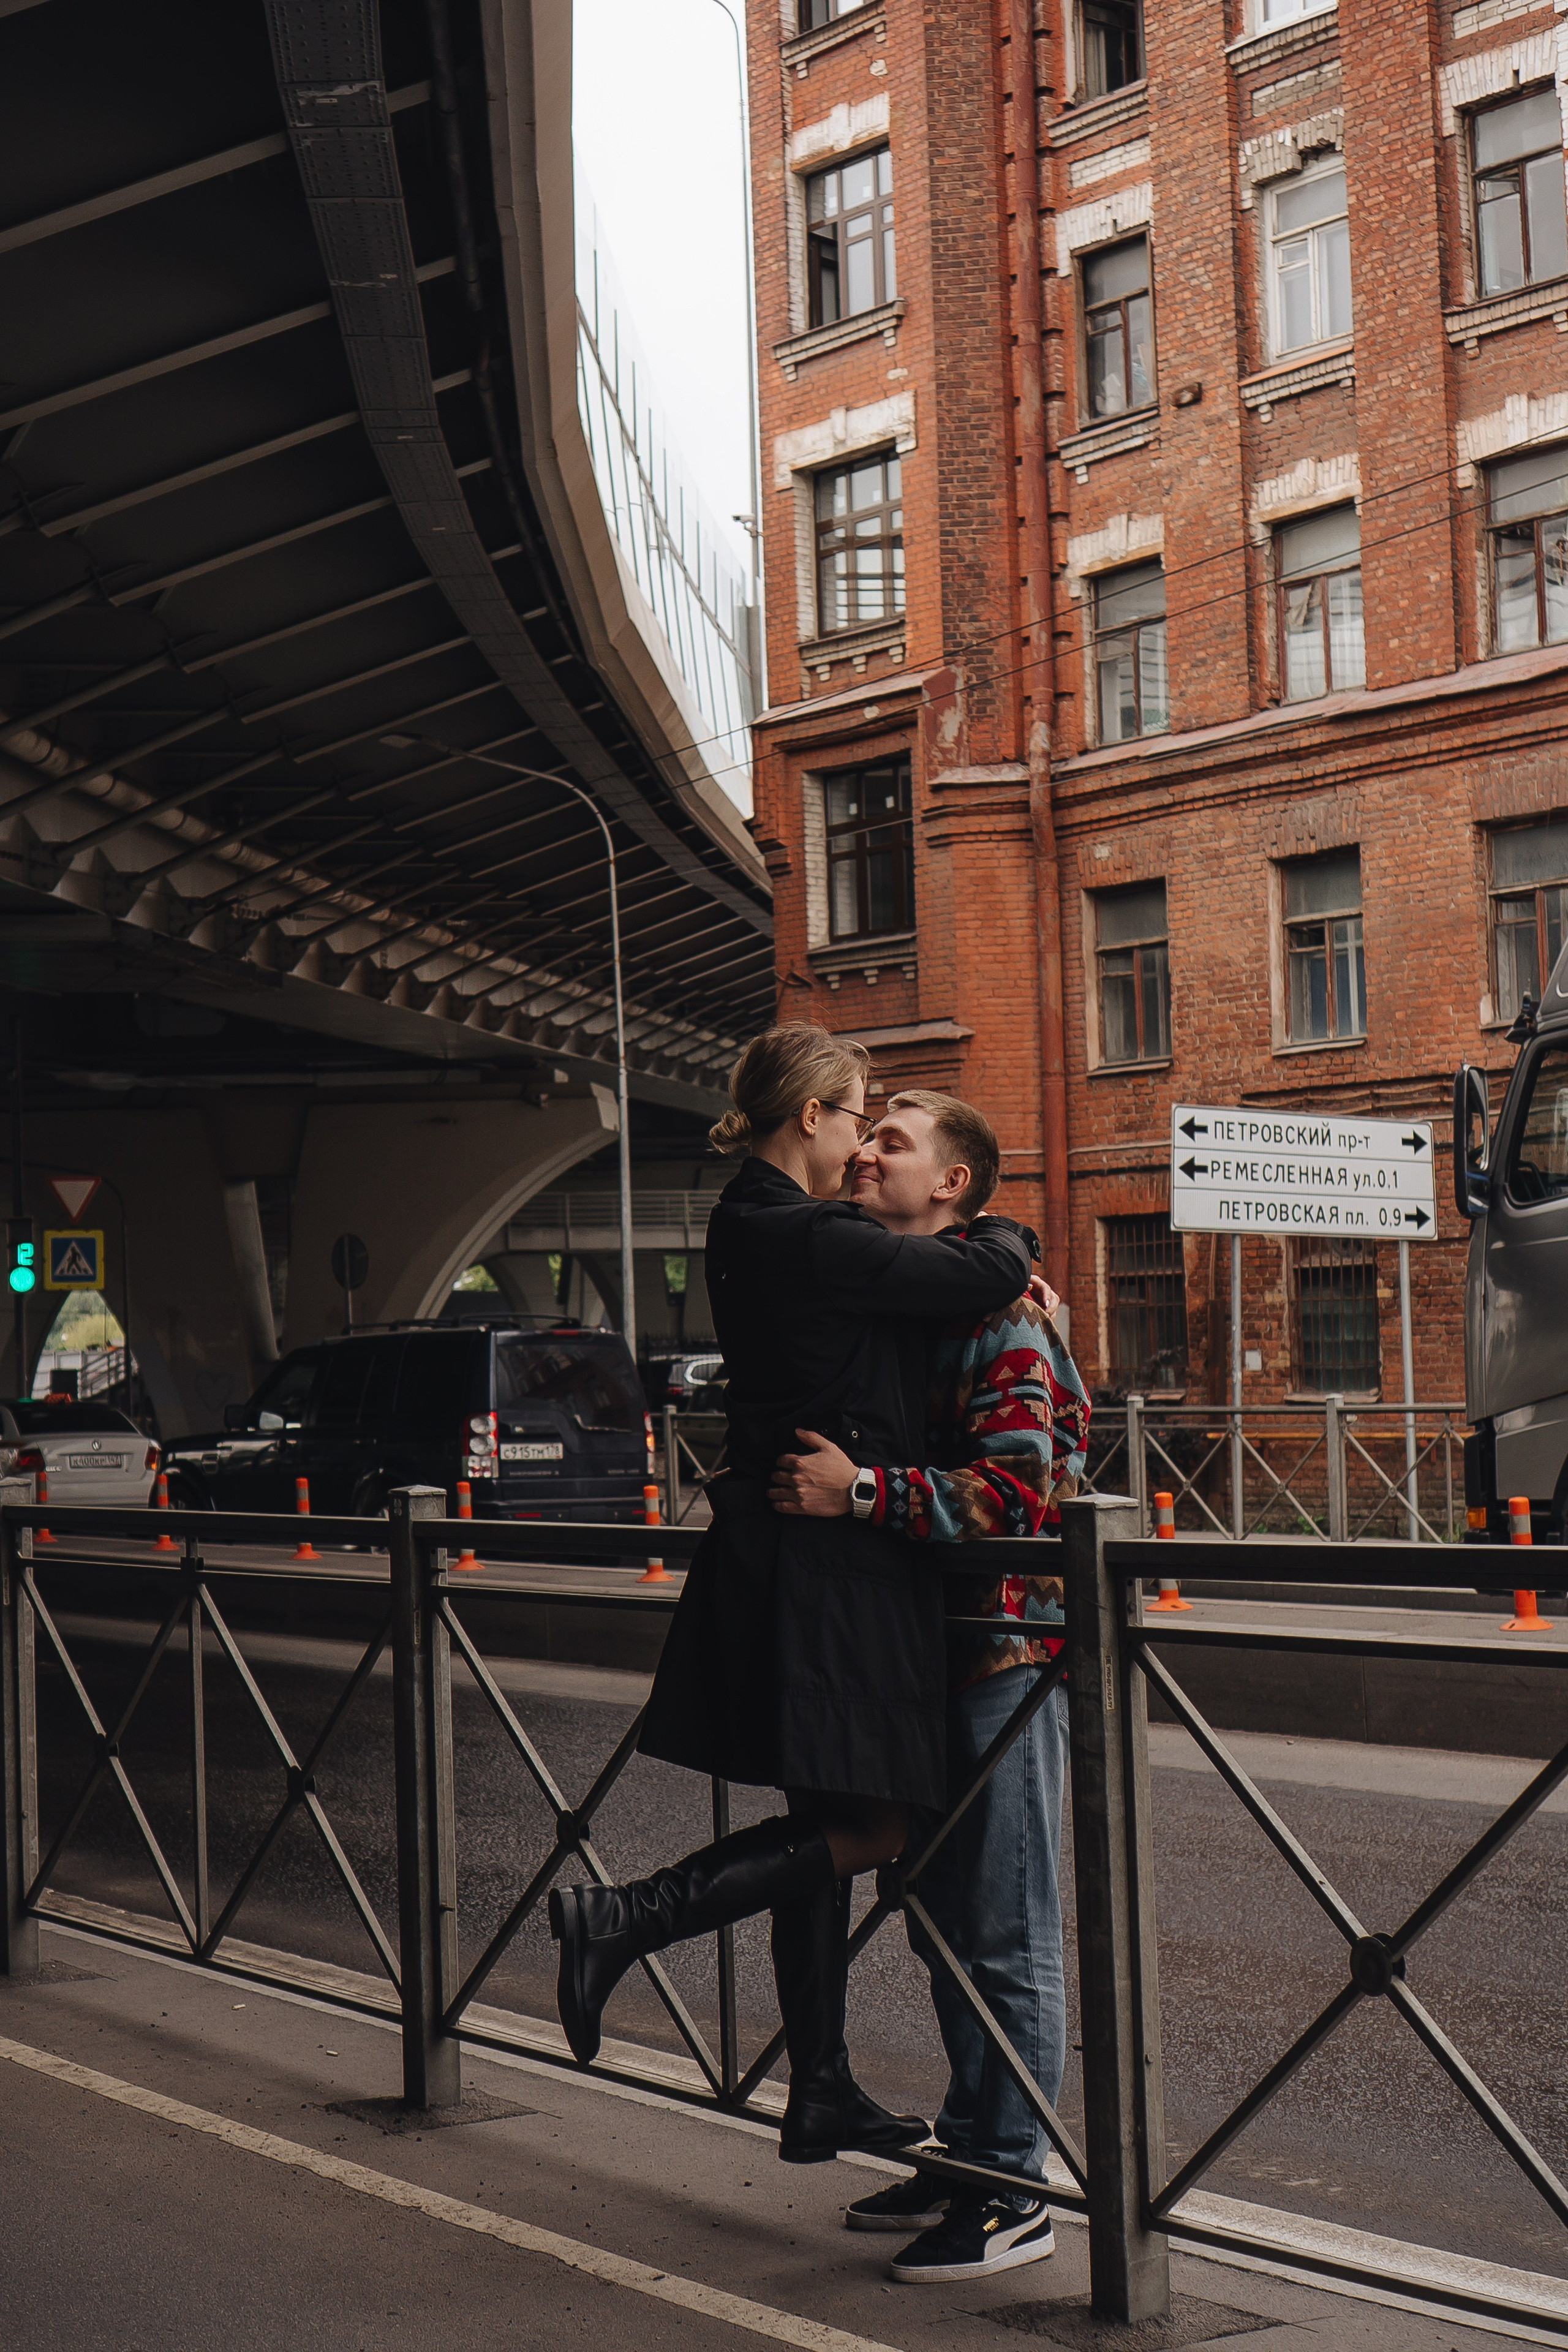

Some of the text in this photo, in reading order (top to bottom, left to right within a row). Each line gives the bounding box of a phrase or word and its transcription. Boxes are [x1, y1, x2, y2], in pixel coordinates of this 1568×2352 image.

[1214, 1121, 1371, 1153] ПЕТРОВСКИЙ пр-т
[1211, 1160, 1348, 1186] РЕМЕСЛЕННАЯ
[1219, 1200, 1401, 1227] ПЕТРОВСКАЯ пл. 0,9
